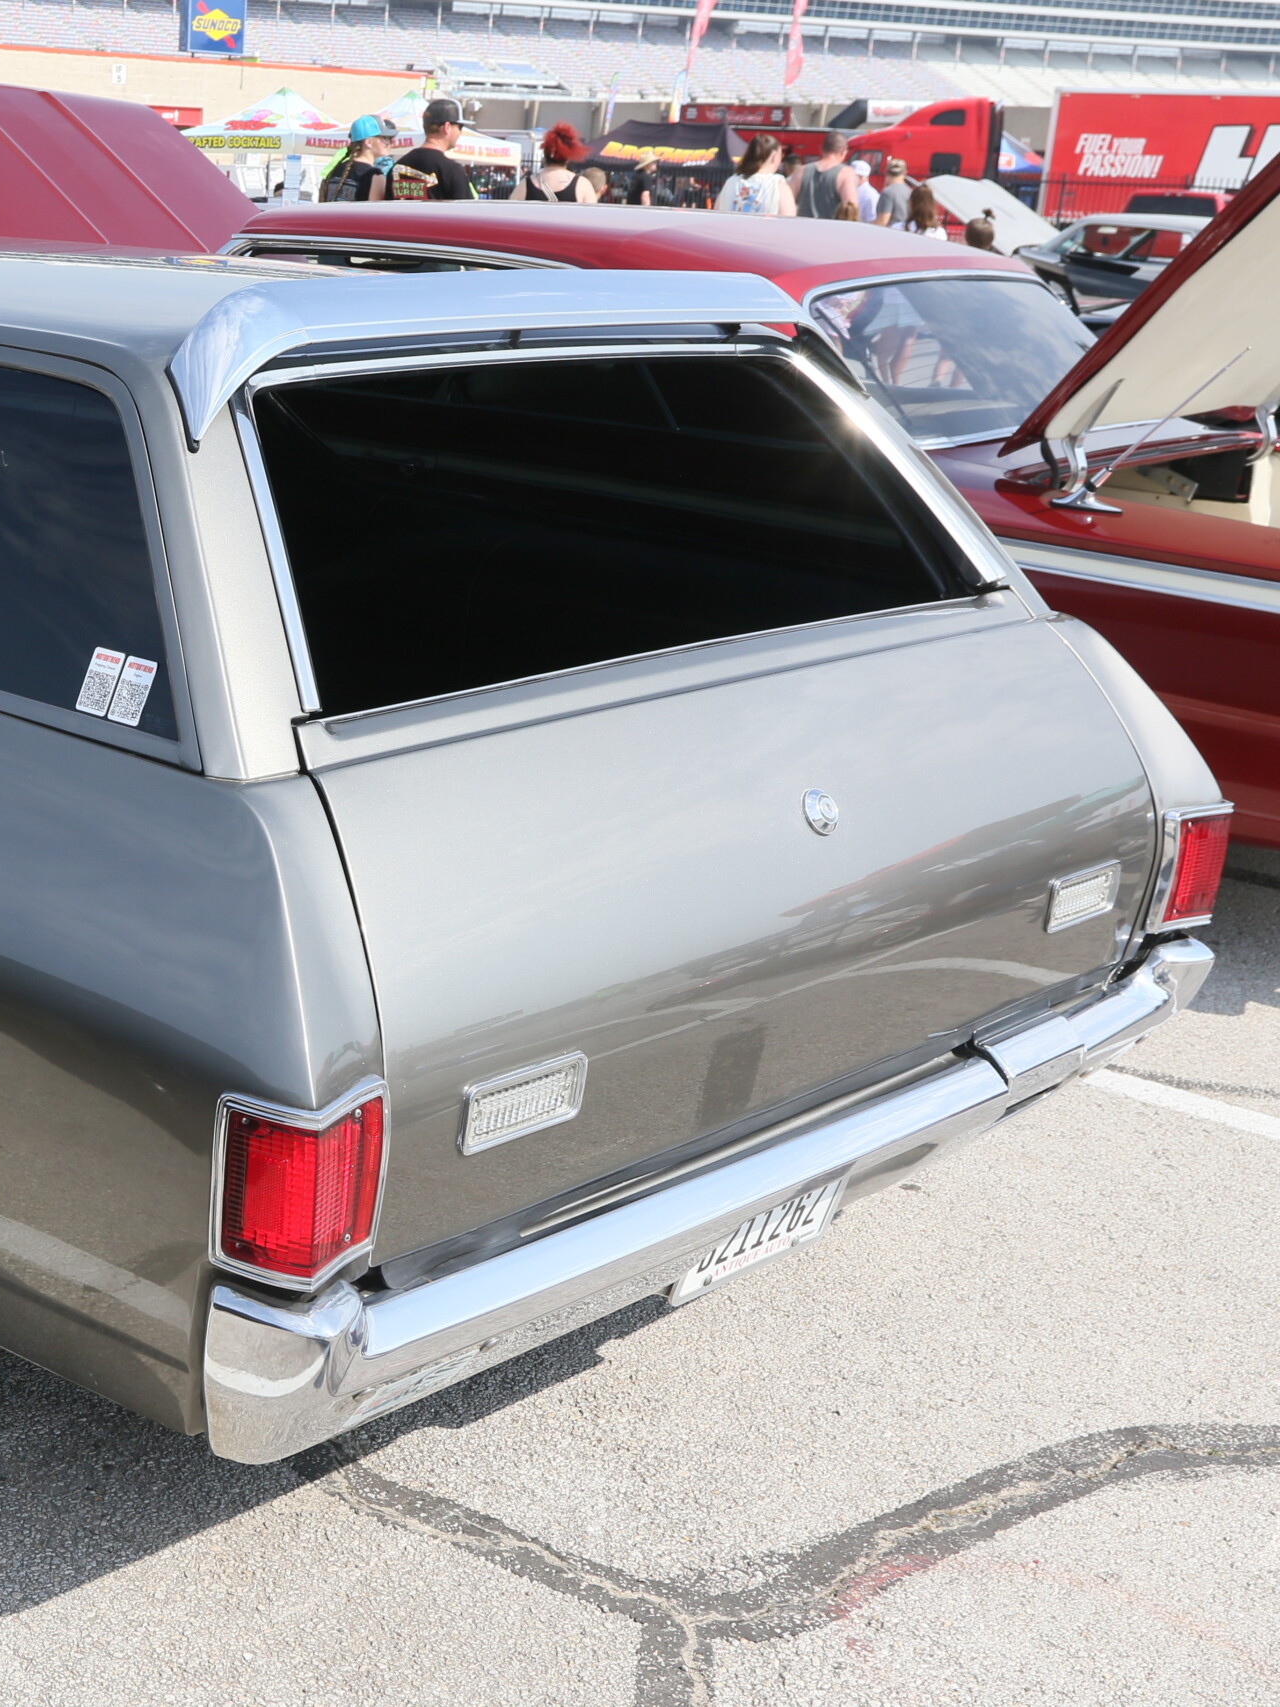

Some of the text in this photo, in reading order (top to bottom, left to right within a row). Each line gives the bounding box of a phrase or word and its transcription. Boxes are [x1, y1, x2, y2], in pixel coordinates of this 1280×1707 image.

[195, 18, 239, 32] SUNOCO
[187, 136, 281, 149] RAFTED COCKTAILS
[1075, 134, 1147, 155] FUEL YOUR
[1077, 154, 1164, 178] PASSION!
[712, 1235, 791, 1277] ANTIQUE AUTO
